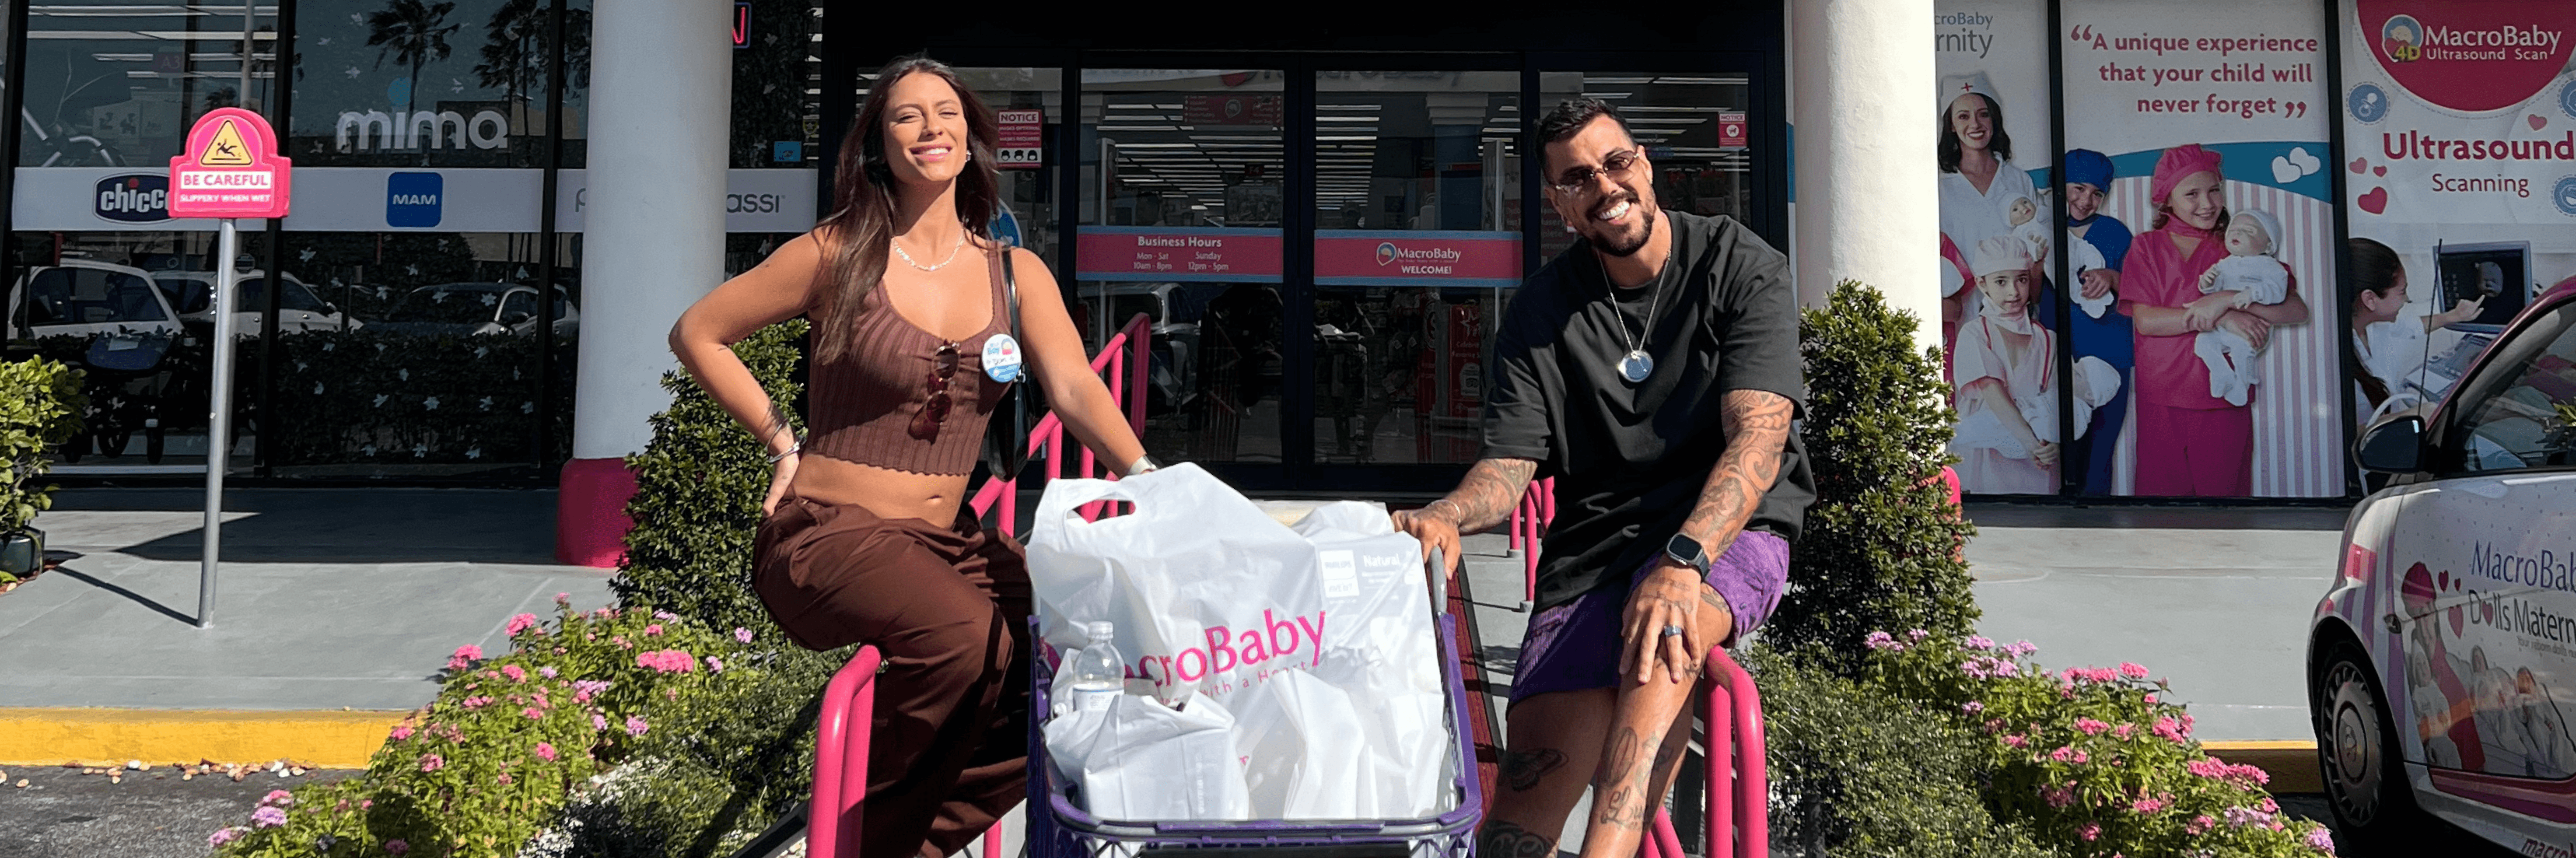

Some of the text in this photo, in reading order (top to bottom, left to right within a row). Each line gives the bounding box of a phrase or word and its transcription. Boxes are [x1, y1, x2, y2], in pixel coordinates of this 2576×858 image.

[2115, 33, 2189, 56] unique
[2196, 33, 2318, 56] experience
[2425, 25, 2562, 55] MacroBaby
[2426, 49, 2548, 60] Ultrasound Scan
[161, 55, 181, 70] A3
[2099, 62, 2313, 87] that your child will
[2138, 99, 2200, 113] never
[335, 110, 508, 150] mima
[2383, 130, 2575, 160] Ultrasound
[184, 175, 268, 186] BE CAREFUL
[2432, 173, 2530, 198] Scanning
[100, 178, 169, 213] chicc
[392, 194, 436, 205] MAM
[1138, 236, 1222, 247] Business Hours
[1195, 252, 1222, 261] Sunday
[1397, 248, 1462, 263] MacroBaby
[1157, 262, 1172, 271] 8pm
[1188, 262, 1207, 271] 12pm
[1213, 263, 1229, 272] 5pm
[1401, 265, 1452, 274] WELCOME!
[1363, 553, 1400, 567] Natural
[1040, 609, 1326, 686] croBaby
